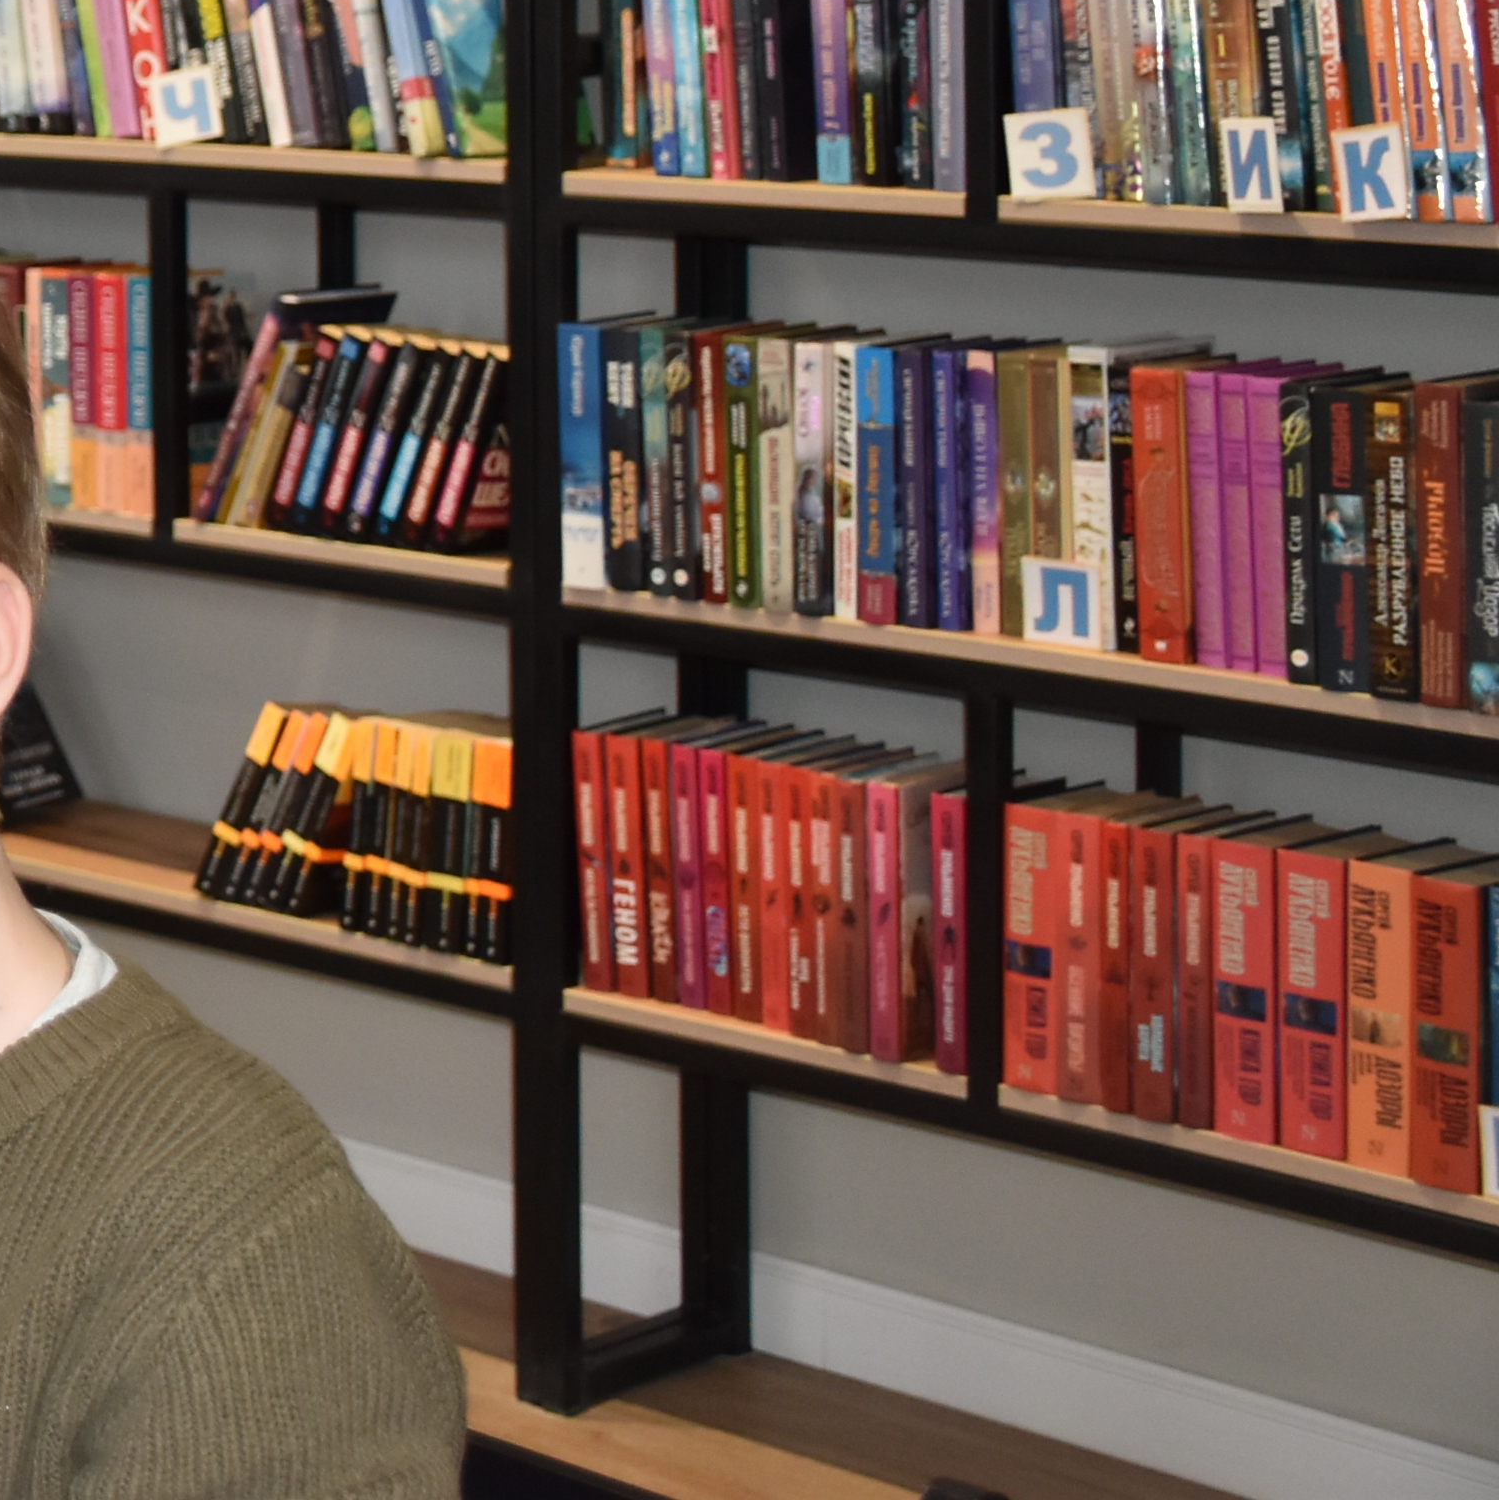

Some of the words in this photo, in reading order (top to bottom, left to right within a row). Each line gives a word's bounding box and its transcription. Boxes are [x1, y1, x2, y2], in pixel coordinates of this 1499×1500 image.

[159, 74, 213, 136] Ч
[1019, 121, 1078, 189] З
[1227, 129, 1275, 203] И
[1345, 137, 1392, 214] К
[1388, 455, 1406, 504] НЕБО
[1033, 567, 1089, 639] Л
[1389, 509, 1409, 647] РАЗРУБЛЕННОЕ
[1007, 825, 1034, 937] ЛУКЬЯНЕНКО
[1217, 860, 1247, 977] ЛУКЬЯНЕНКО
[610, 877, 639, 967] ГЕНОМ
[1287, 871, 1318, 989] ЛУКЬЯНЕНКО
[1350, 883, 1379, 1000] ЛУКЬЯНЕНКО
[1414, 896, 1445, 1018] ЛУКЬЯНЕНКО
[1373, 1054, 1404, 1131] ДОЗОРЫ
[1438, 1073, 1472, 1149] ДОЗОРЫ
